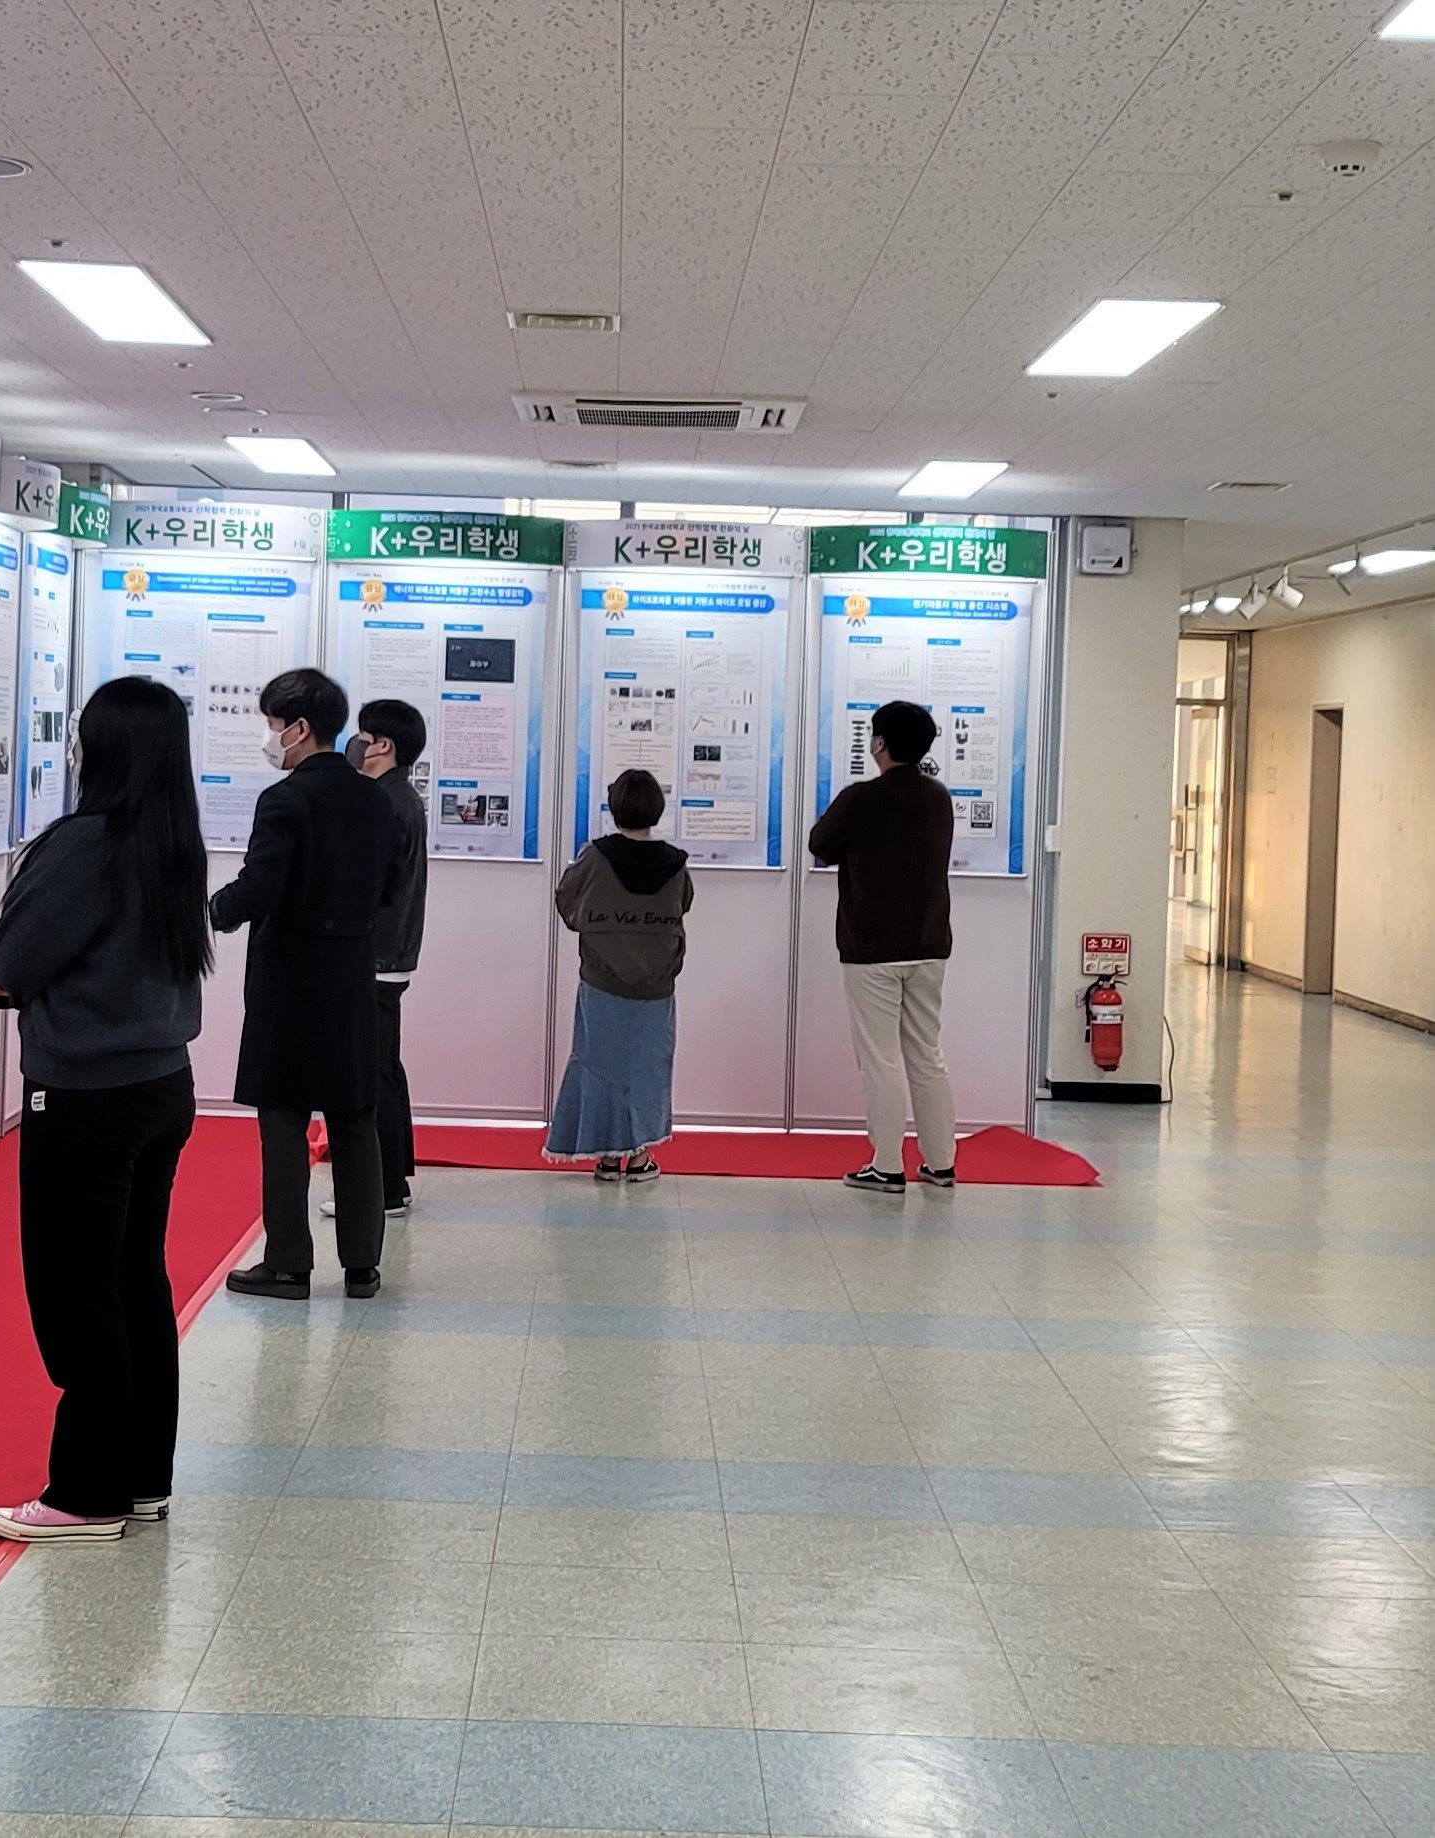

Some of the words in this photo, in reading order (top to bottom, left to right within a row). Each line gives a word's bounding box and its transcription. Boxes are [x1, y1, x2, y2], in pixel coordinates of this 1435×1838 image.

[125, 517, 274, 551] K+우리학생
[370, 525, 519, 560] K+우리학생
[614, 535, 762, 568] K+우리학생
[857, 539, 1008, 574] K+우리학생
[588, 910, 609, 922] La
[614, 910, 640, 924] Vie
